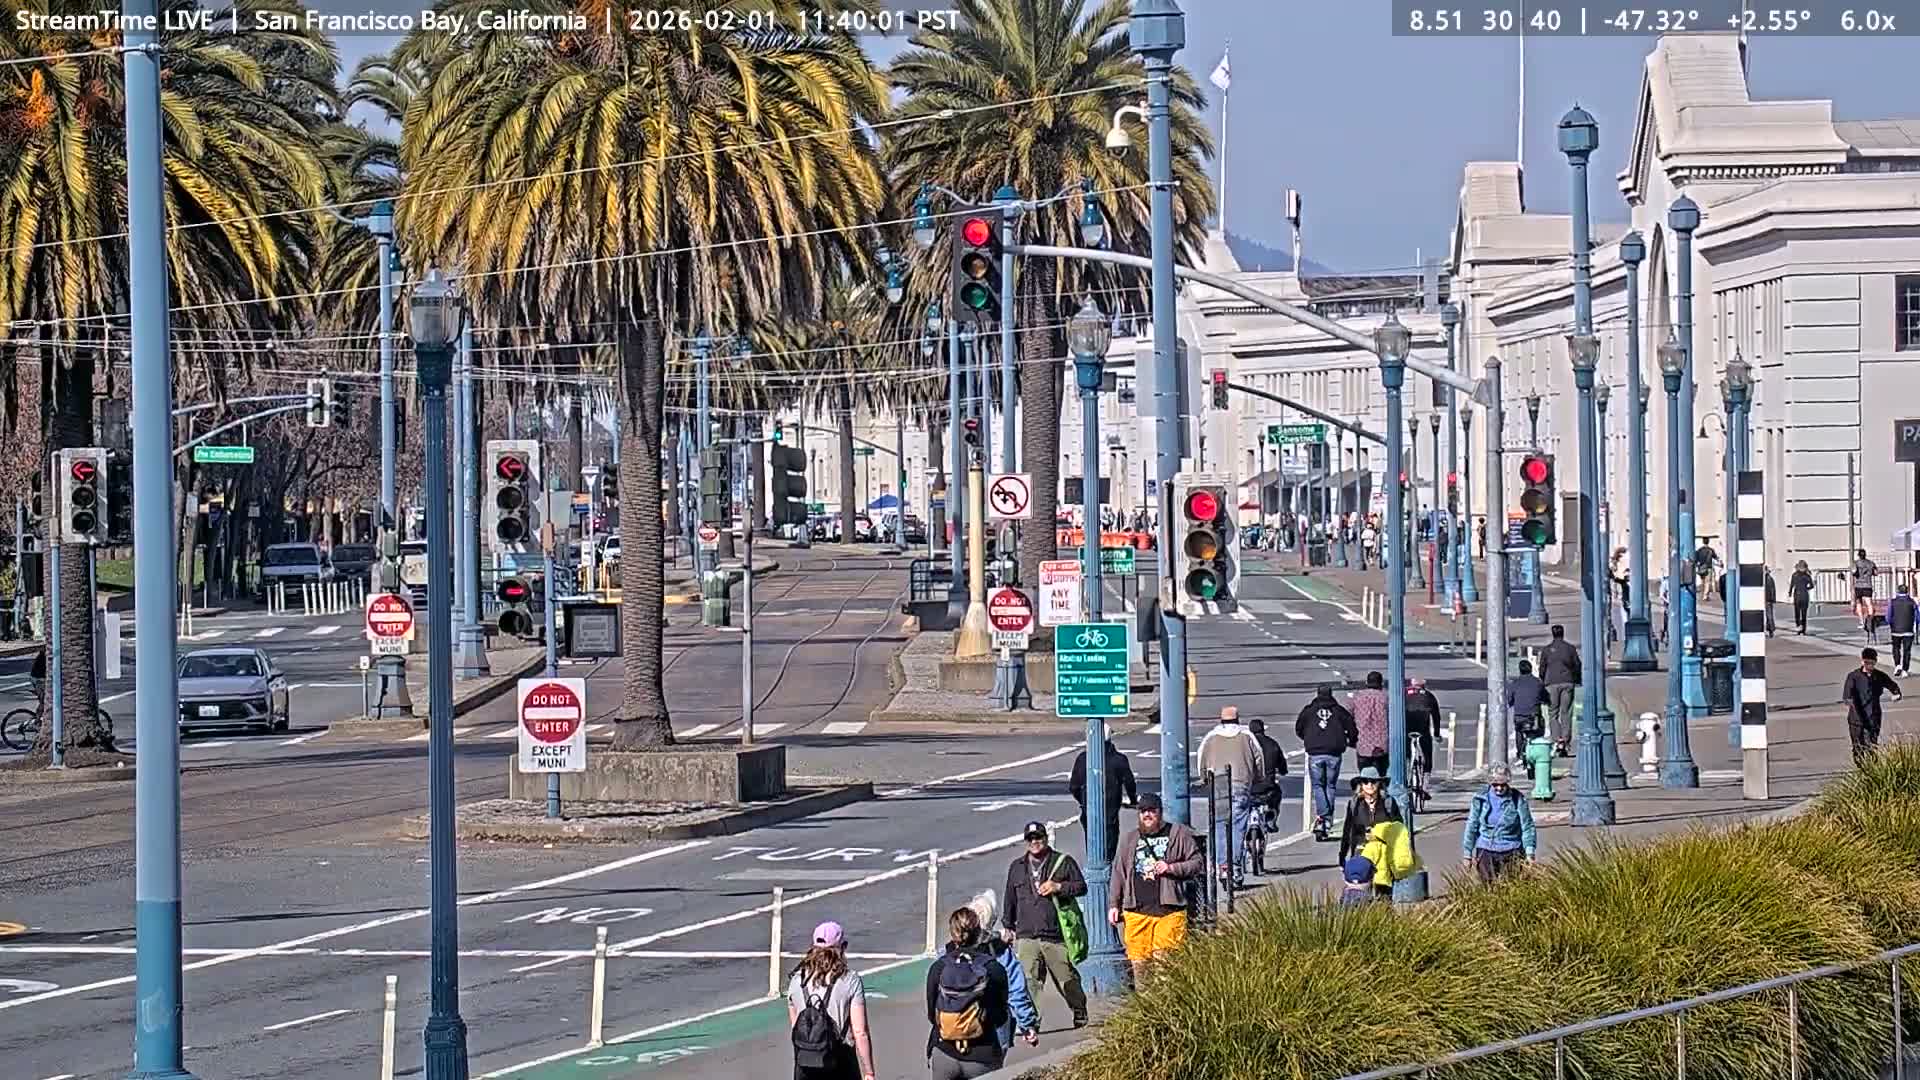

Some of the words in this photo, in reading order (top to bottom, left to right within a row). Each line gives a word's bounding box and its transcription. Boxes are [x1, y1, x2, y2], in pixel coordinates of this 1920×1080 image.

[1277, 426, 1315, 435] Sansome
[1051, 589, 1069, 598] ANY
[994, 597, 1006, 605] DO
[1051, 600, 1070, 610] TIME
[998, 617, 1023, 625] ENTER
[1000, 640, 1021, 648] MUNI
[532, 695, 547, 705] DO
[550, 695, 570, 705] NOT
[535, 721, 569, 732] ENTER
[532, 745, 572, 756] EXCEPT
[537, 758, 566, 768] MUNI
[503, 906, 654, 924] NO
